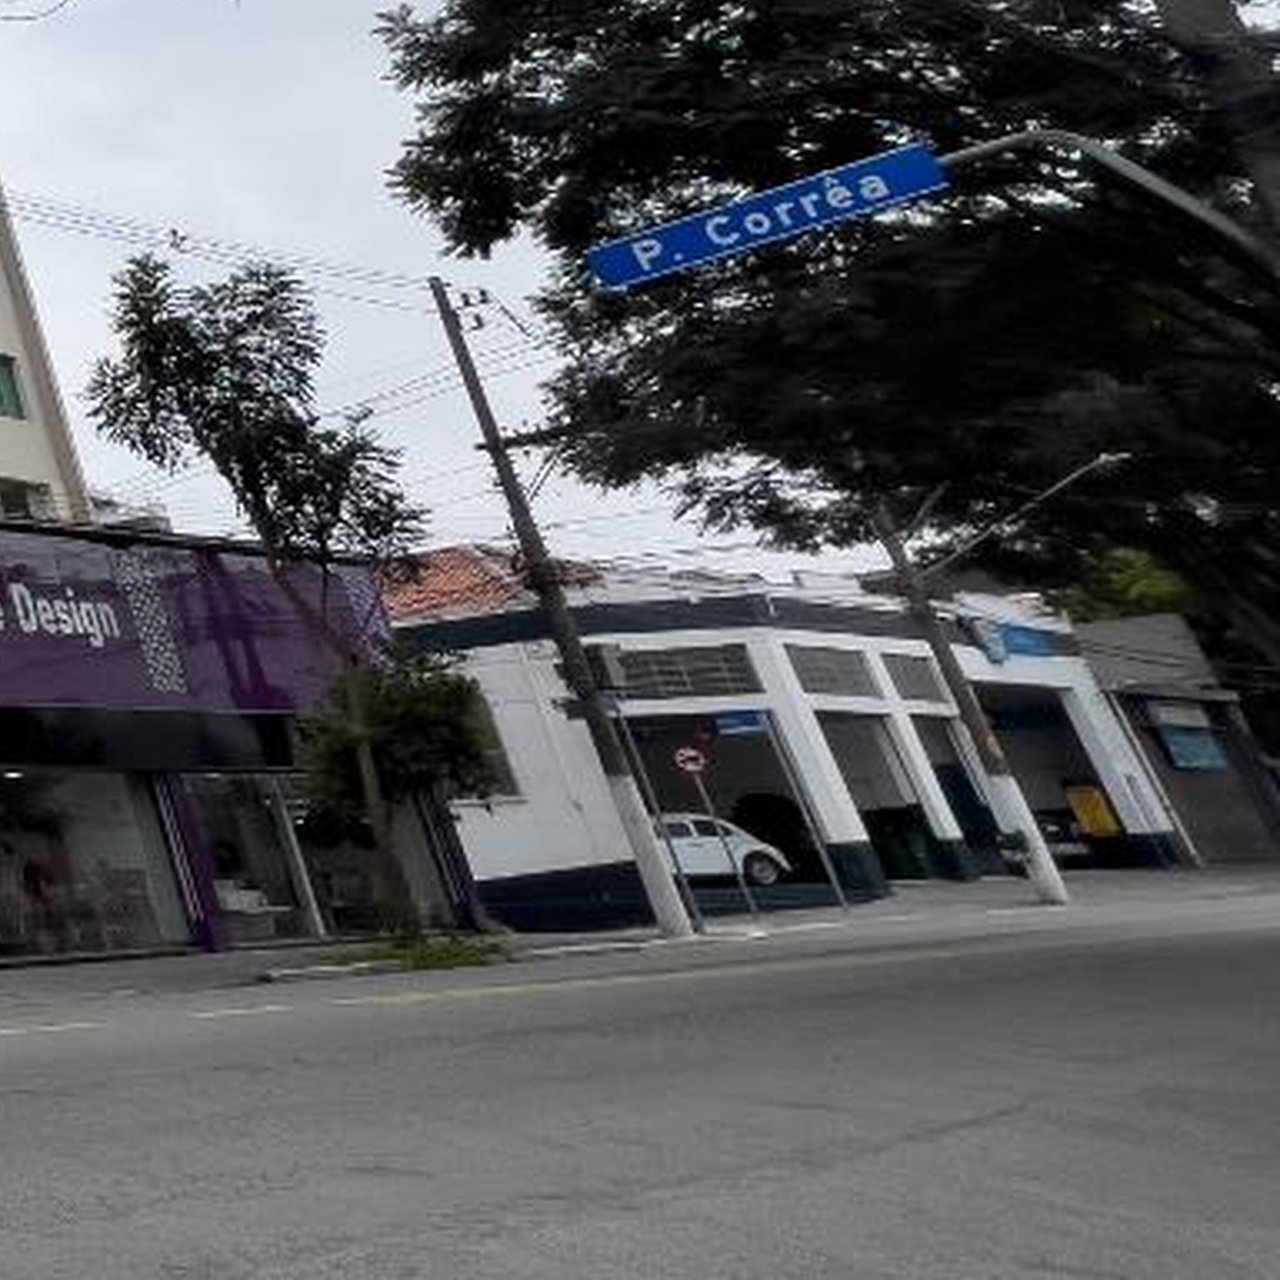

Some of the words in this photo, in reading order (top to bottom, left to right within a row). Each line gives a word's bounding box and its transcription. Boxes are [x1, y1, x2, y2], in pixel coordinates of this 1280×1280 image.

[631, 237, 683, 271] P.
[705, 175, 890, 245] Corrêa
[7, 582, 121, 648] Design
